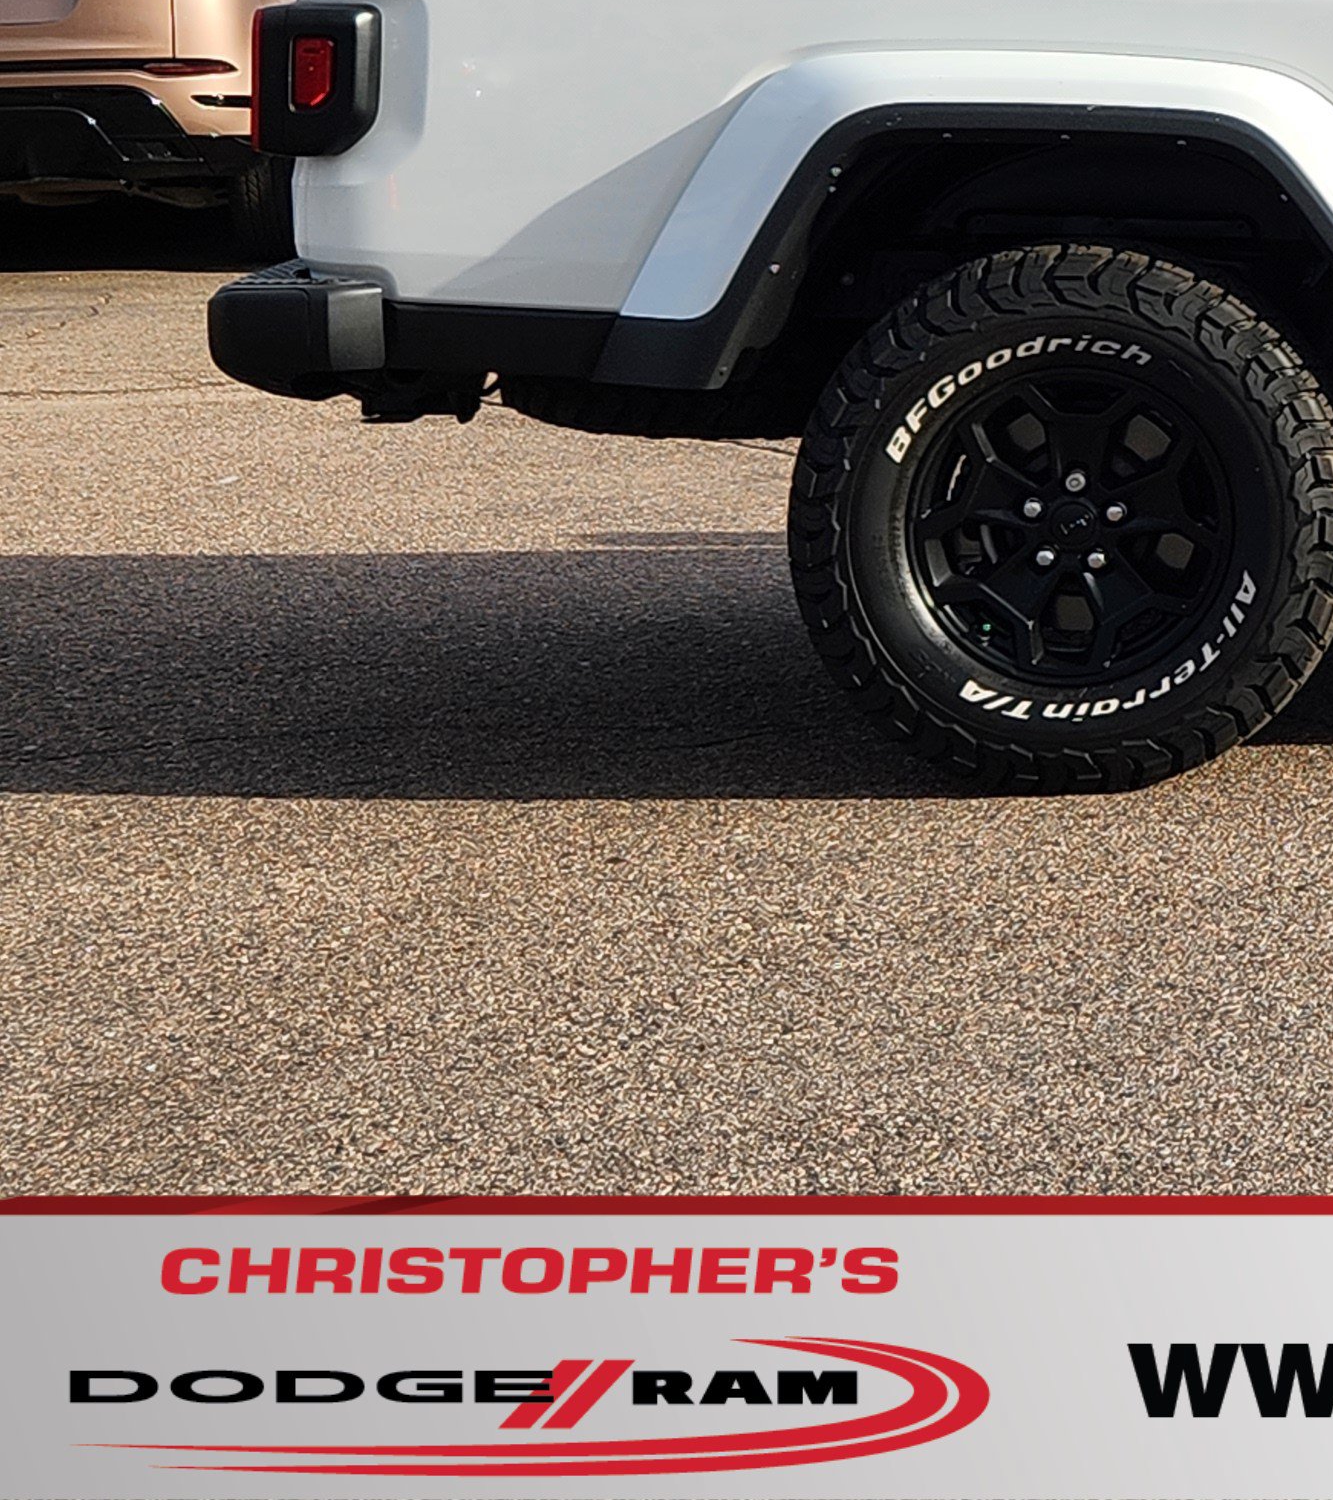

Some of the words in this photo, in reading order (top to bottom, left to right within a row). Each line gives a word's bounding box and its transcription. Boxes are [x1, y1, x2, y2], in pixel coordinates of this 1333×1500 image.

[885, 334, 1153, 465] BFGoodrich
[958, 679, 1034, 721] T/A
[1041, 569, 1257, 723] All-Terrain
